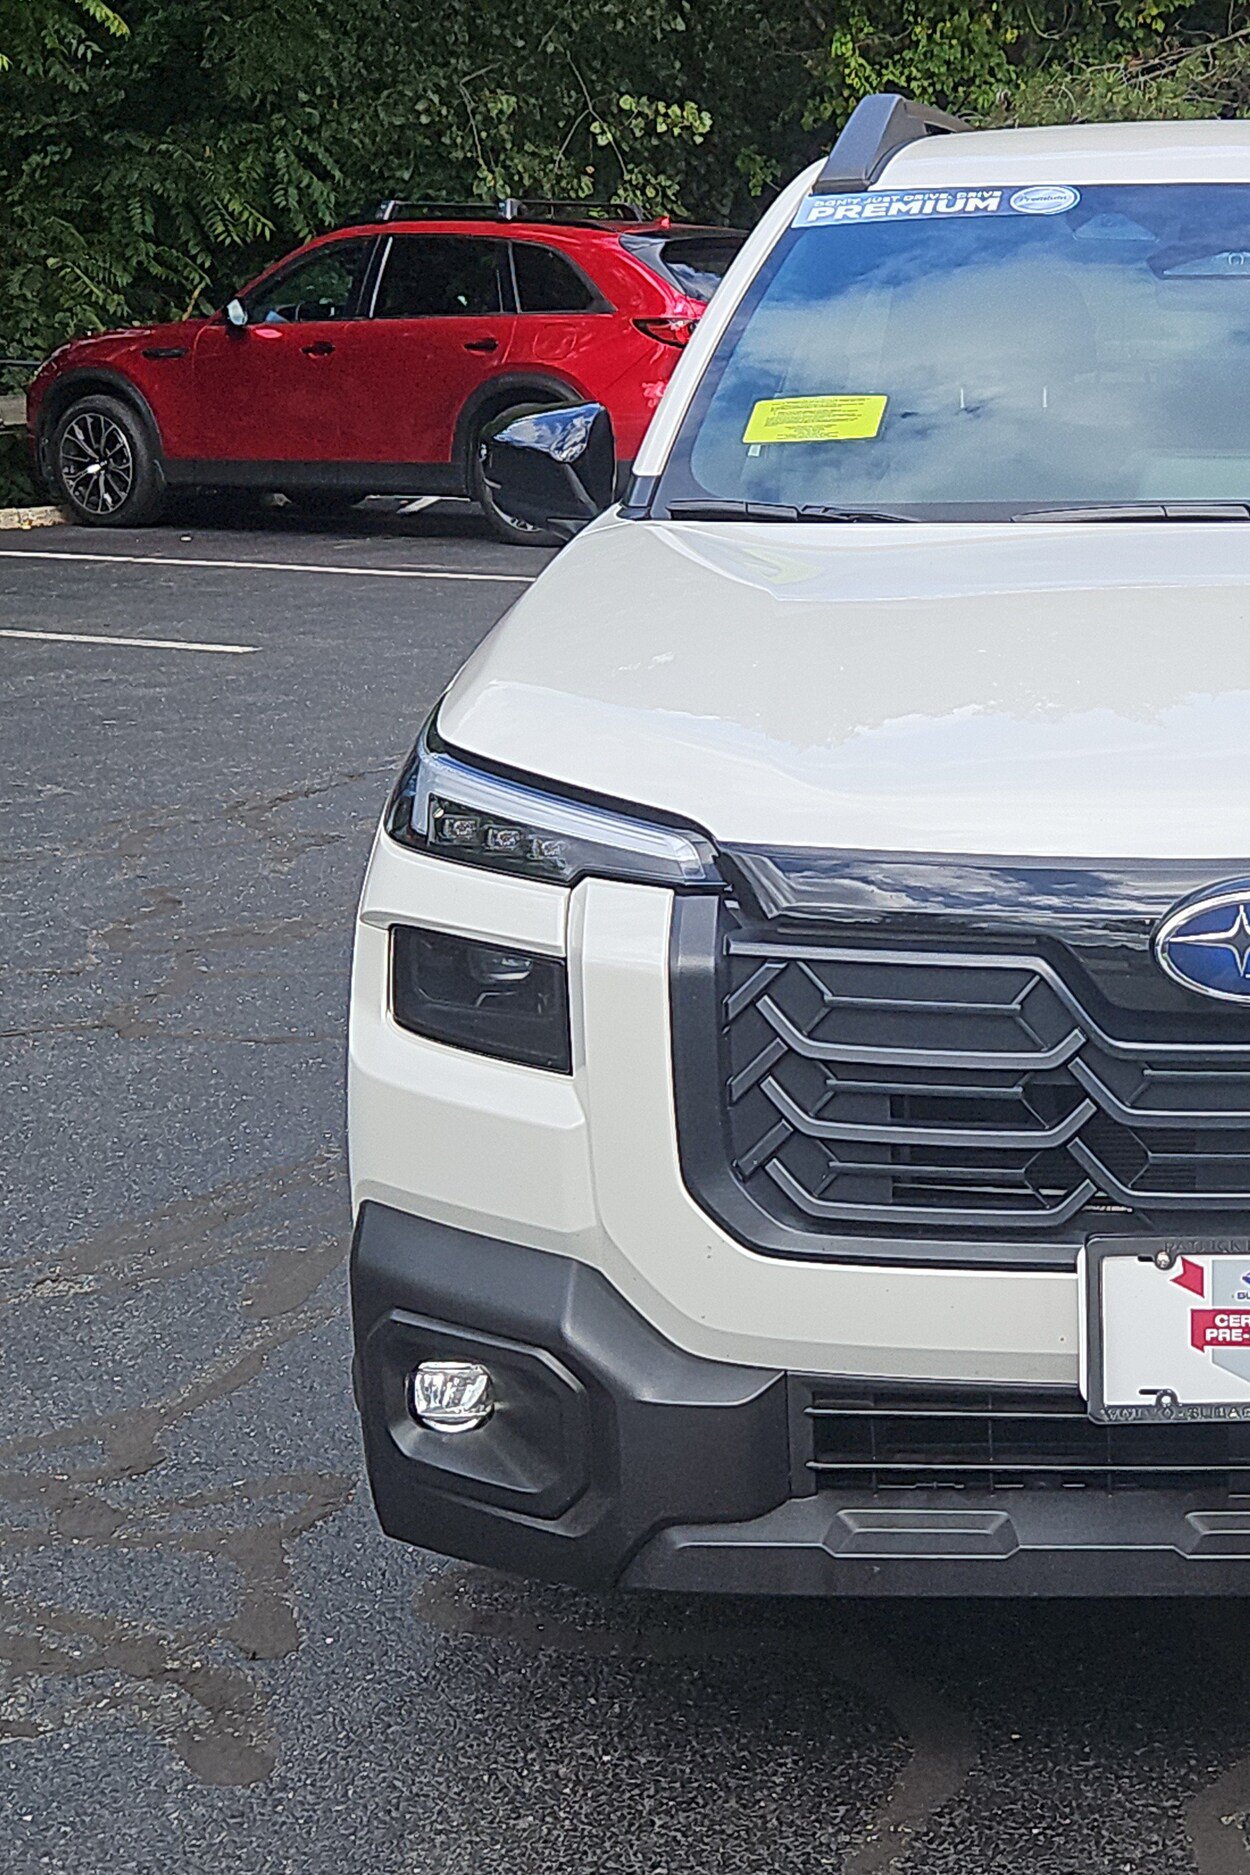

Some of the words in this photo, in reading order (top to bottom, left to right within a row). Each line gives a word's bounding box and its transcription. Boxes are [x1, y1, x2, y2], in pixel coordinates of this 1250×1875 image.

[814, 197, 861, 207] DON'T
[865, 195, 901, 204] JUST
[956, 190, 1002, 199] DRIVE
[806, 197, 1001, 222] PREMIUM
